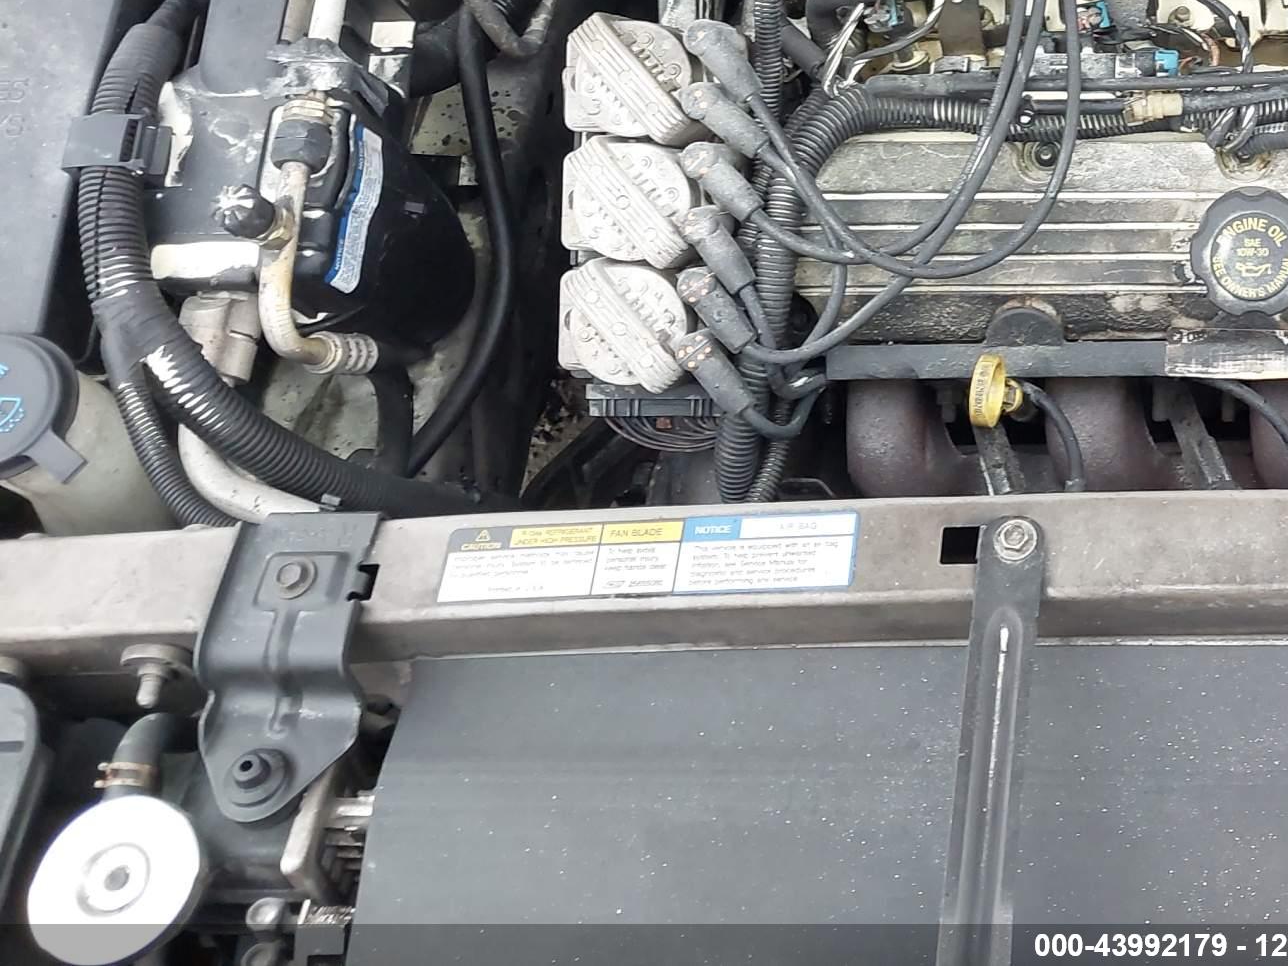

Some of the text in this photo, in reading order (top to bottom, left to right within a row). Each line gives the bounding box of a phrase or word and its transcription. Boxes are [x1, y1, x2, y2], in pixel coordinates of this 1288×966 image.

[1267, 225, 1288, 248] OIL
[1243, 238, 1262, 248] SAE
[1236, 247, 1270, 257] 10W-30
[1220, 275, 1267, 299] OWNER'S
[609, 528, 664, 537] FAN BLADE
[694, 524, 733, 536] NOTICE
[560, 535, 598, 543] PRESSURE
